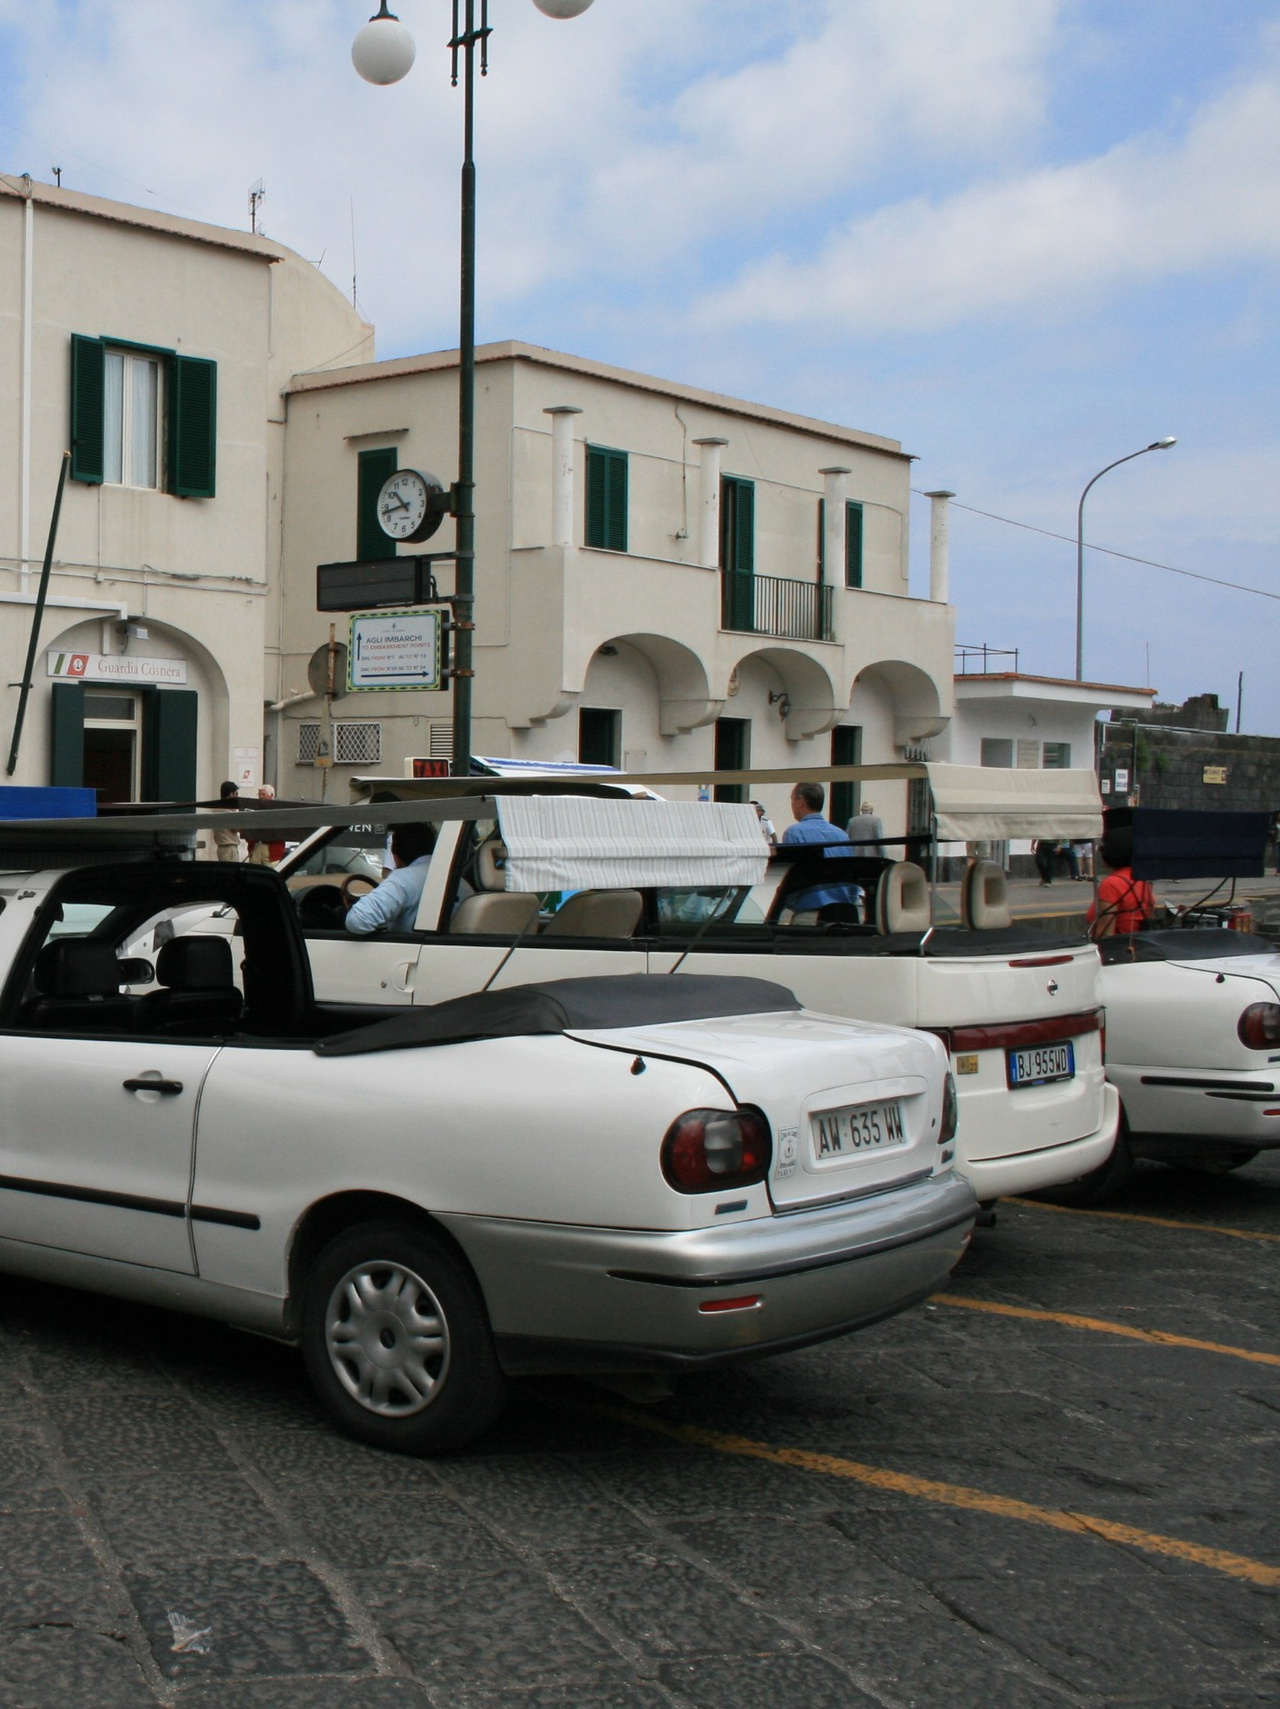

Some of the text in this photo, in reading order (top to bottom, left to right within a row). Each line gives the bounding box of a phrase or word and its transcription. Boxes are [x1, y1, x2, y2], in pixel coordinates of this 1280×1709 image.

[98, 660, 180, 677] Guardia Costiera
[414, 761, 448, 777] TAXI
[1018, 1053, 1032, 1078] BJ
[1035, 1048, 1066, 1074] 955WD
[820, 1104, 903, 1153] AW 635 WW
